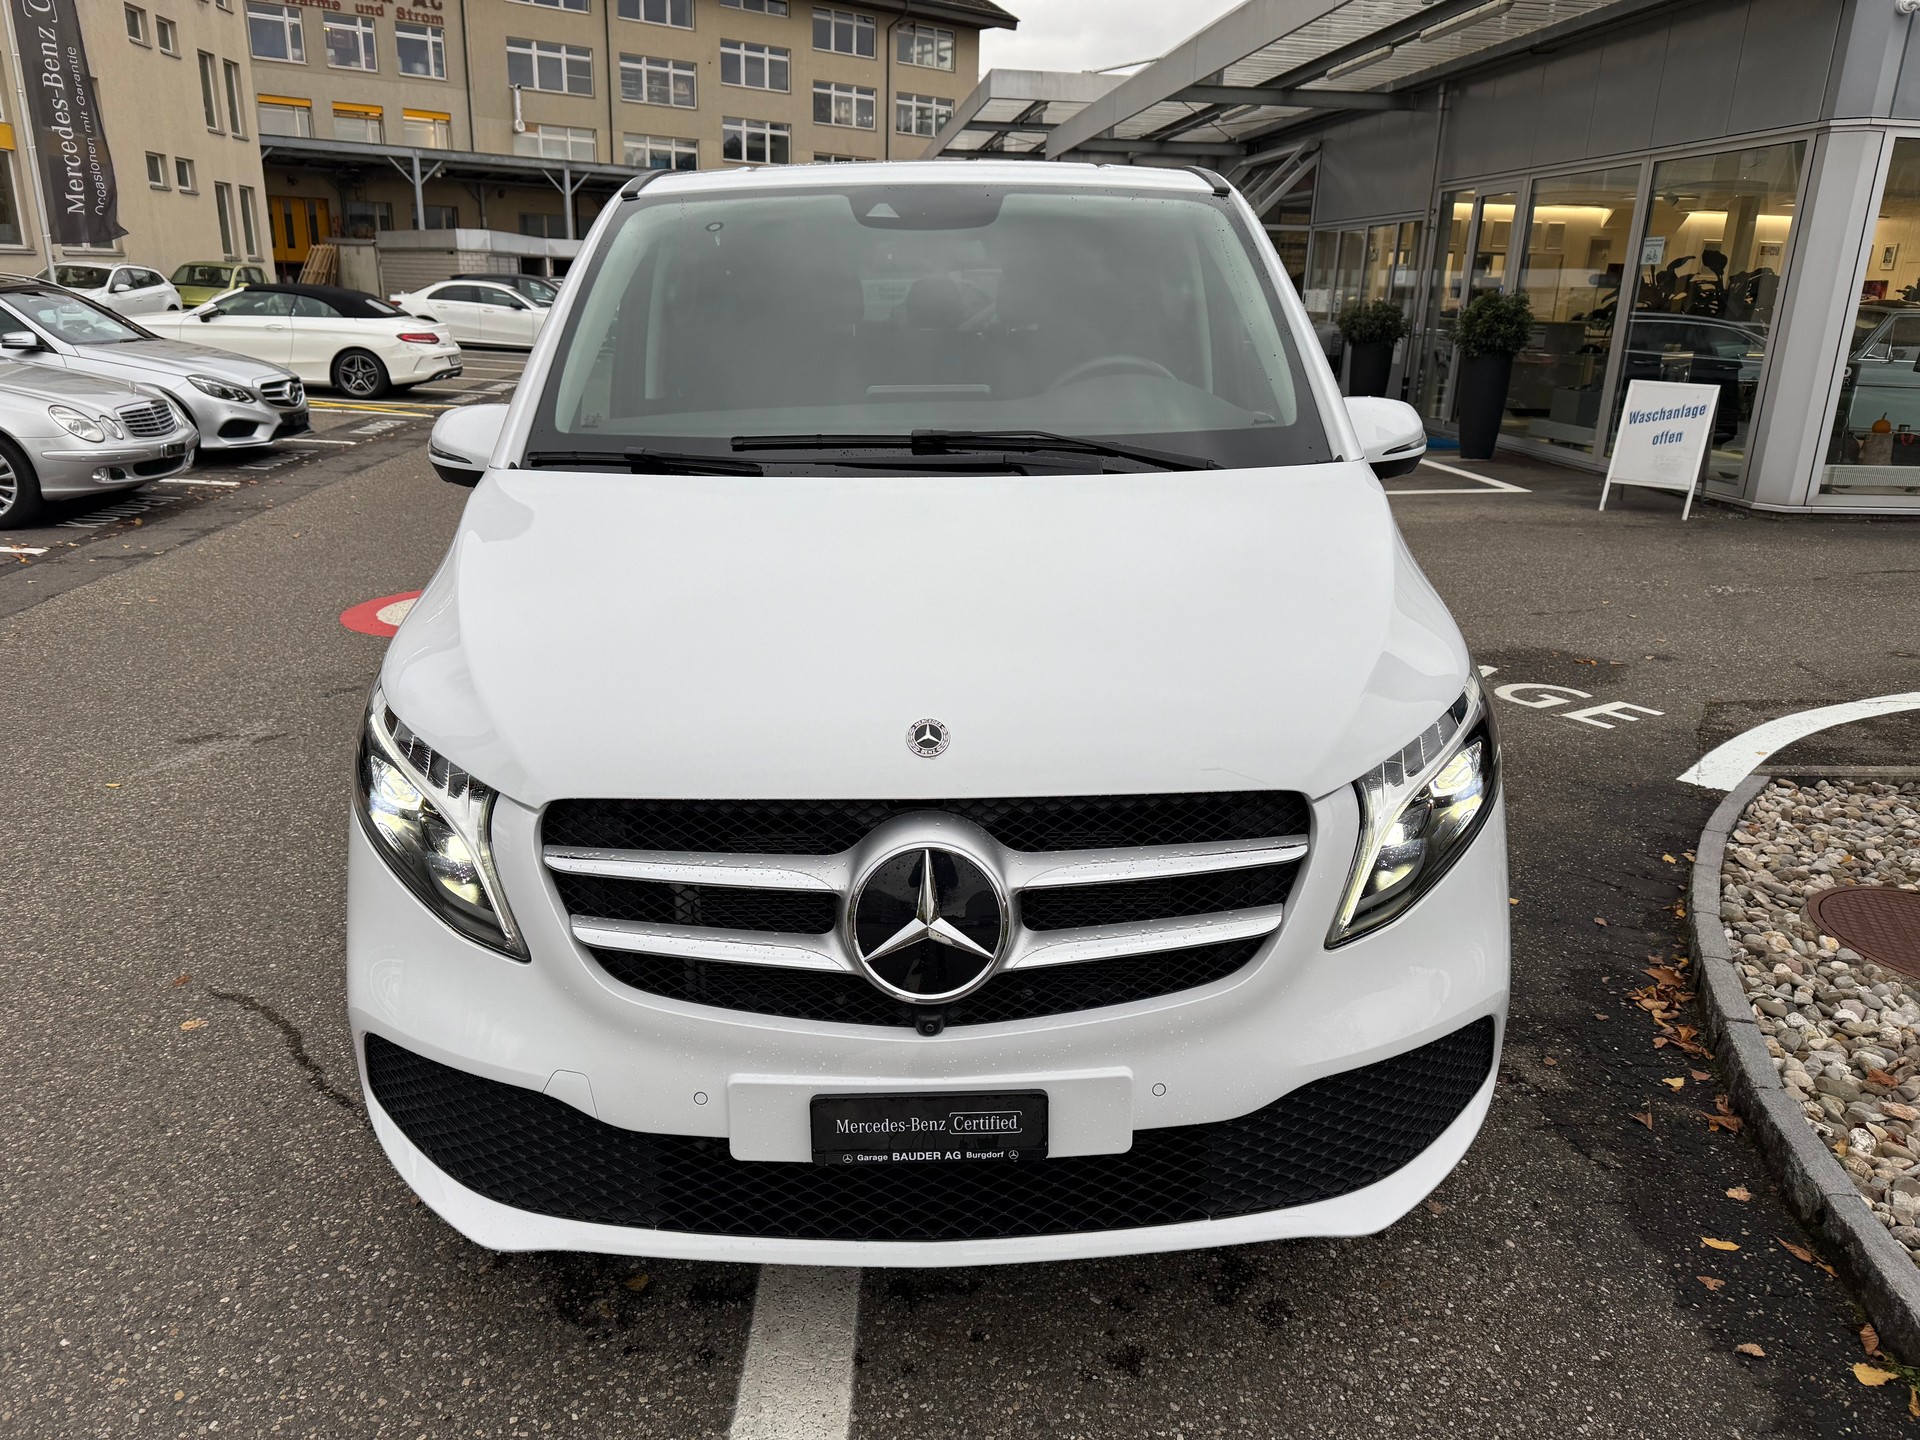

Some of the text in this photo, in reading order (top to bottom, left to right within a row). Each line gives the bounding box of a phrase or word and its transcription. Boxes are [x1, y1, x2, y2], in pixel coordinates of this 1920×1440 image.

[355, 2, 384, 17] und
[396, 6, 444, 25] Strom
[67, 46, 86, 106] Garantie
[37, 26, 86, 216] Mercedes-Benz
[80, 110, 92, 133] mit
[1629, 404, 1707, 424] Waschanlage
[1652, 430, 1684, 445] offen
[836, 1115, 1018, 1134] Mercedes-Benz Certified
[857, 1150, 1005, 1162] Garage BAUDER AG Burgdorf
